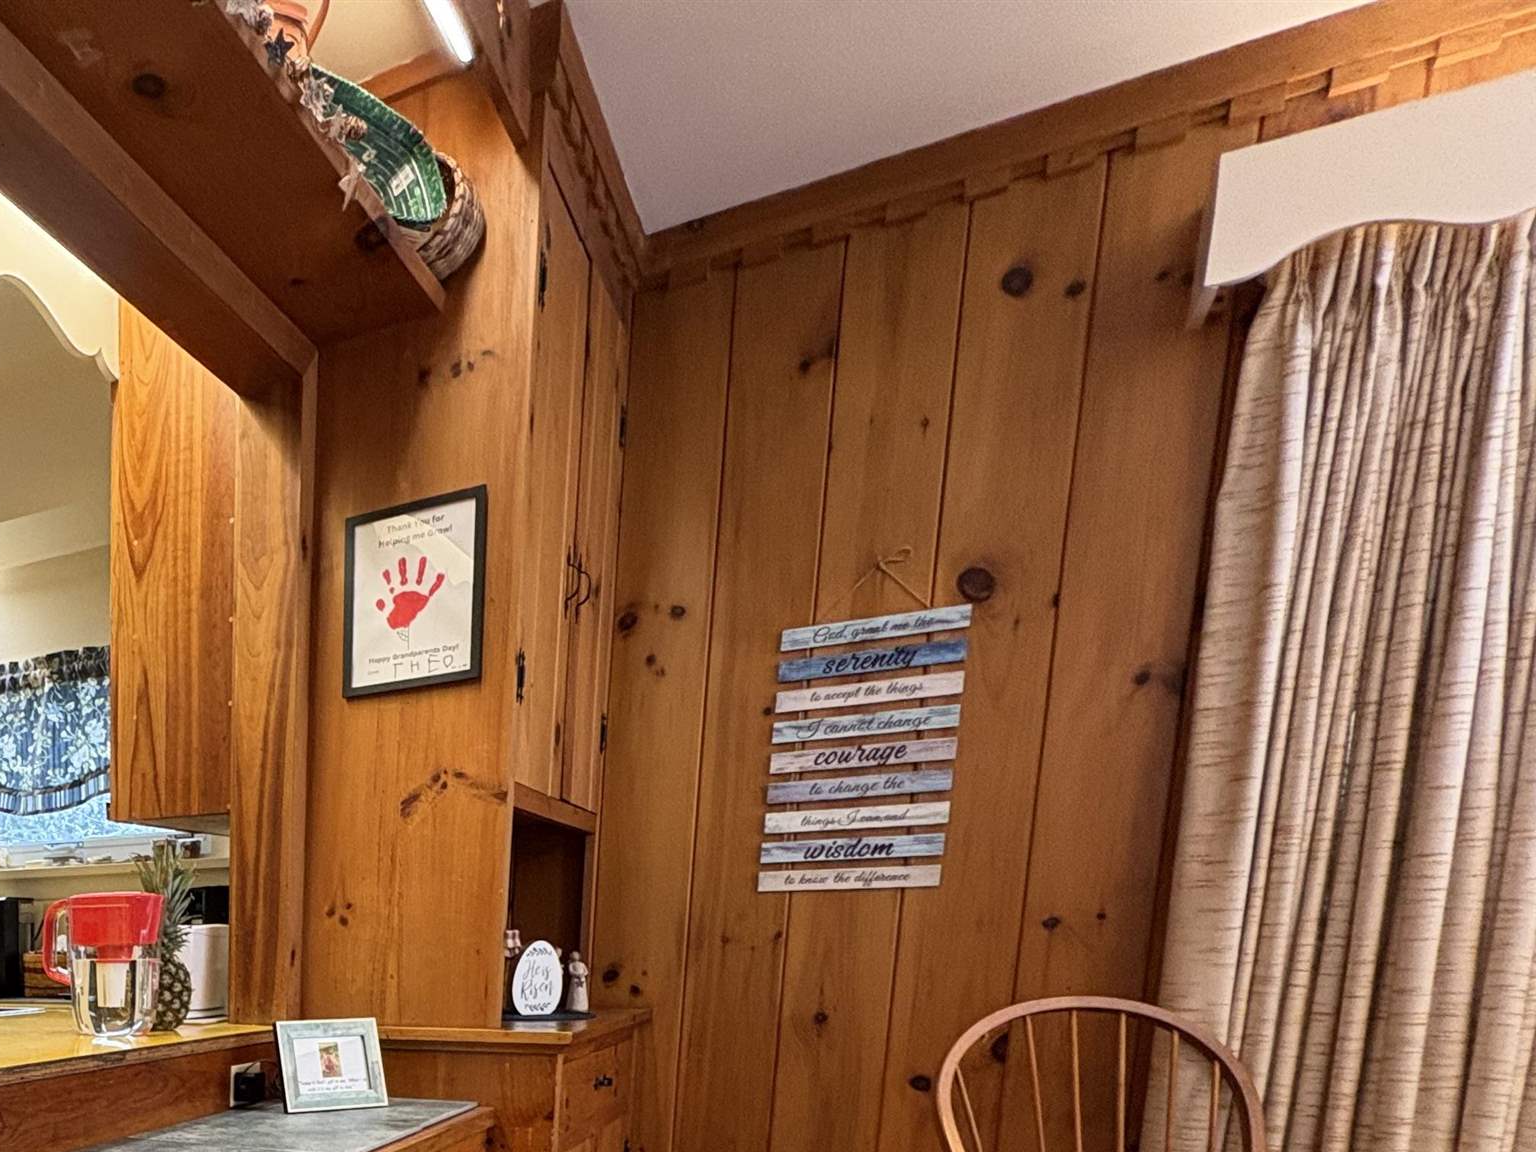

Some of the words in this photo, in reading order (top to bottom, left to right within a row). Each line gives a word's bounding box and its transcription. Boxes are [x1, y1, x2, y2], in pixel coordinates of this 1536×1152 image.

[386, 522, 412, 534] Thank
[432, 513, 446, 524] for
[914, 615, 935, 630] the
[368, 656, 392, 665] Happy
[822, 645, 918, 674] serenity
[810, 691, 821, 702] to
[823, 686, 863, 703] accept
[863, 684, 882, 696] the
[886, 681, 924, 695] things
[796, 718, 824, 739] I
[823, 716, 875, 735] cannot
[877, 714, 932, 730] change
[814, 743, 907, 767] courage
[808, 782, 823, 796] to
[828, 776, 879, 798] change
[882, 773, 906, 791] the
[800, 815, 835, 829] things
[803, 838, 895, 860] wisdom
[784, 874, 796, 885] to
[798, 874, 830, 885] know
[832, 871, 850, 883] the
[854, 870, 911, 887] difference
[523, 960, 541, 980] He
[541, 965, 552, 980] is
[521, 980, 553, 1001] Risen
